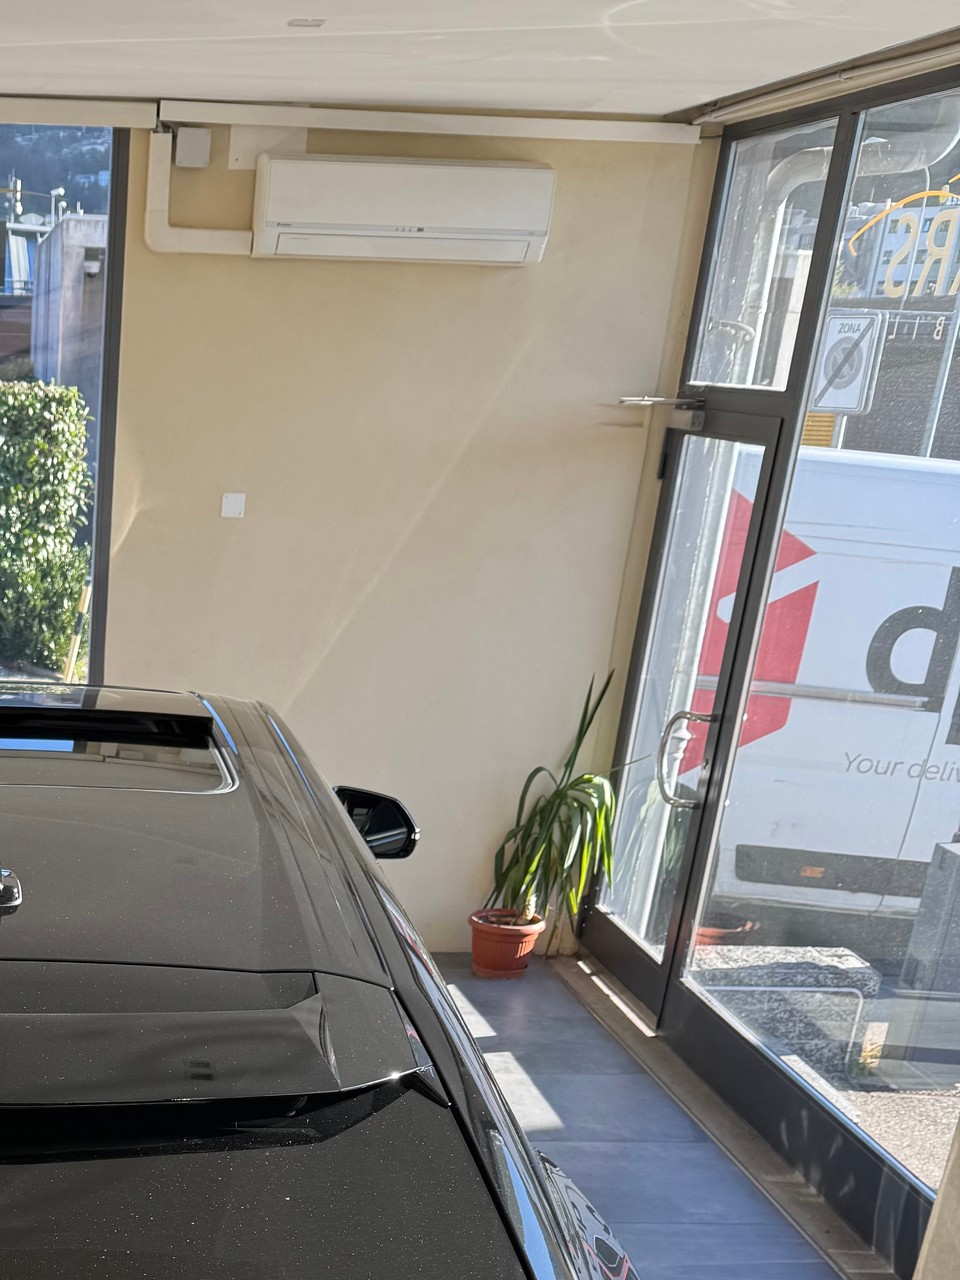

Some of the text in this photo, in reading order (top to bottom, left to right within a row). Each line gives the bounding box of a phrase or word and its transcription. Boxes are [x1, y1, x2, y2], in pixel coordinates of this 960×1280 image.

[837, 320, 861, 334] ZONA
[866, 566, 960, 744] d
[845, 752, 901, 776] Your
